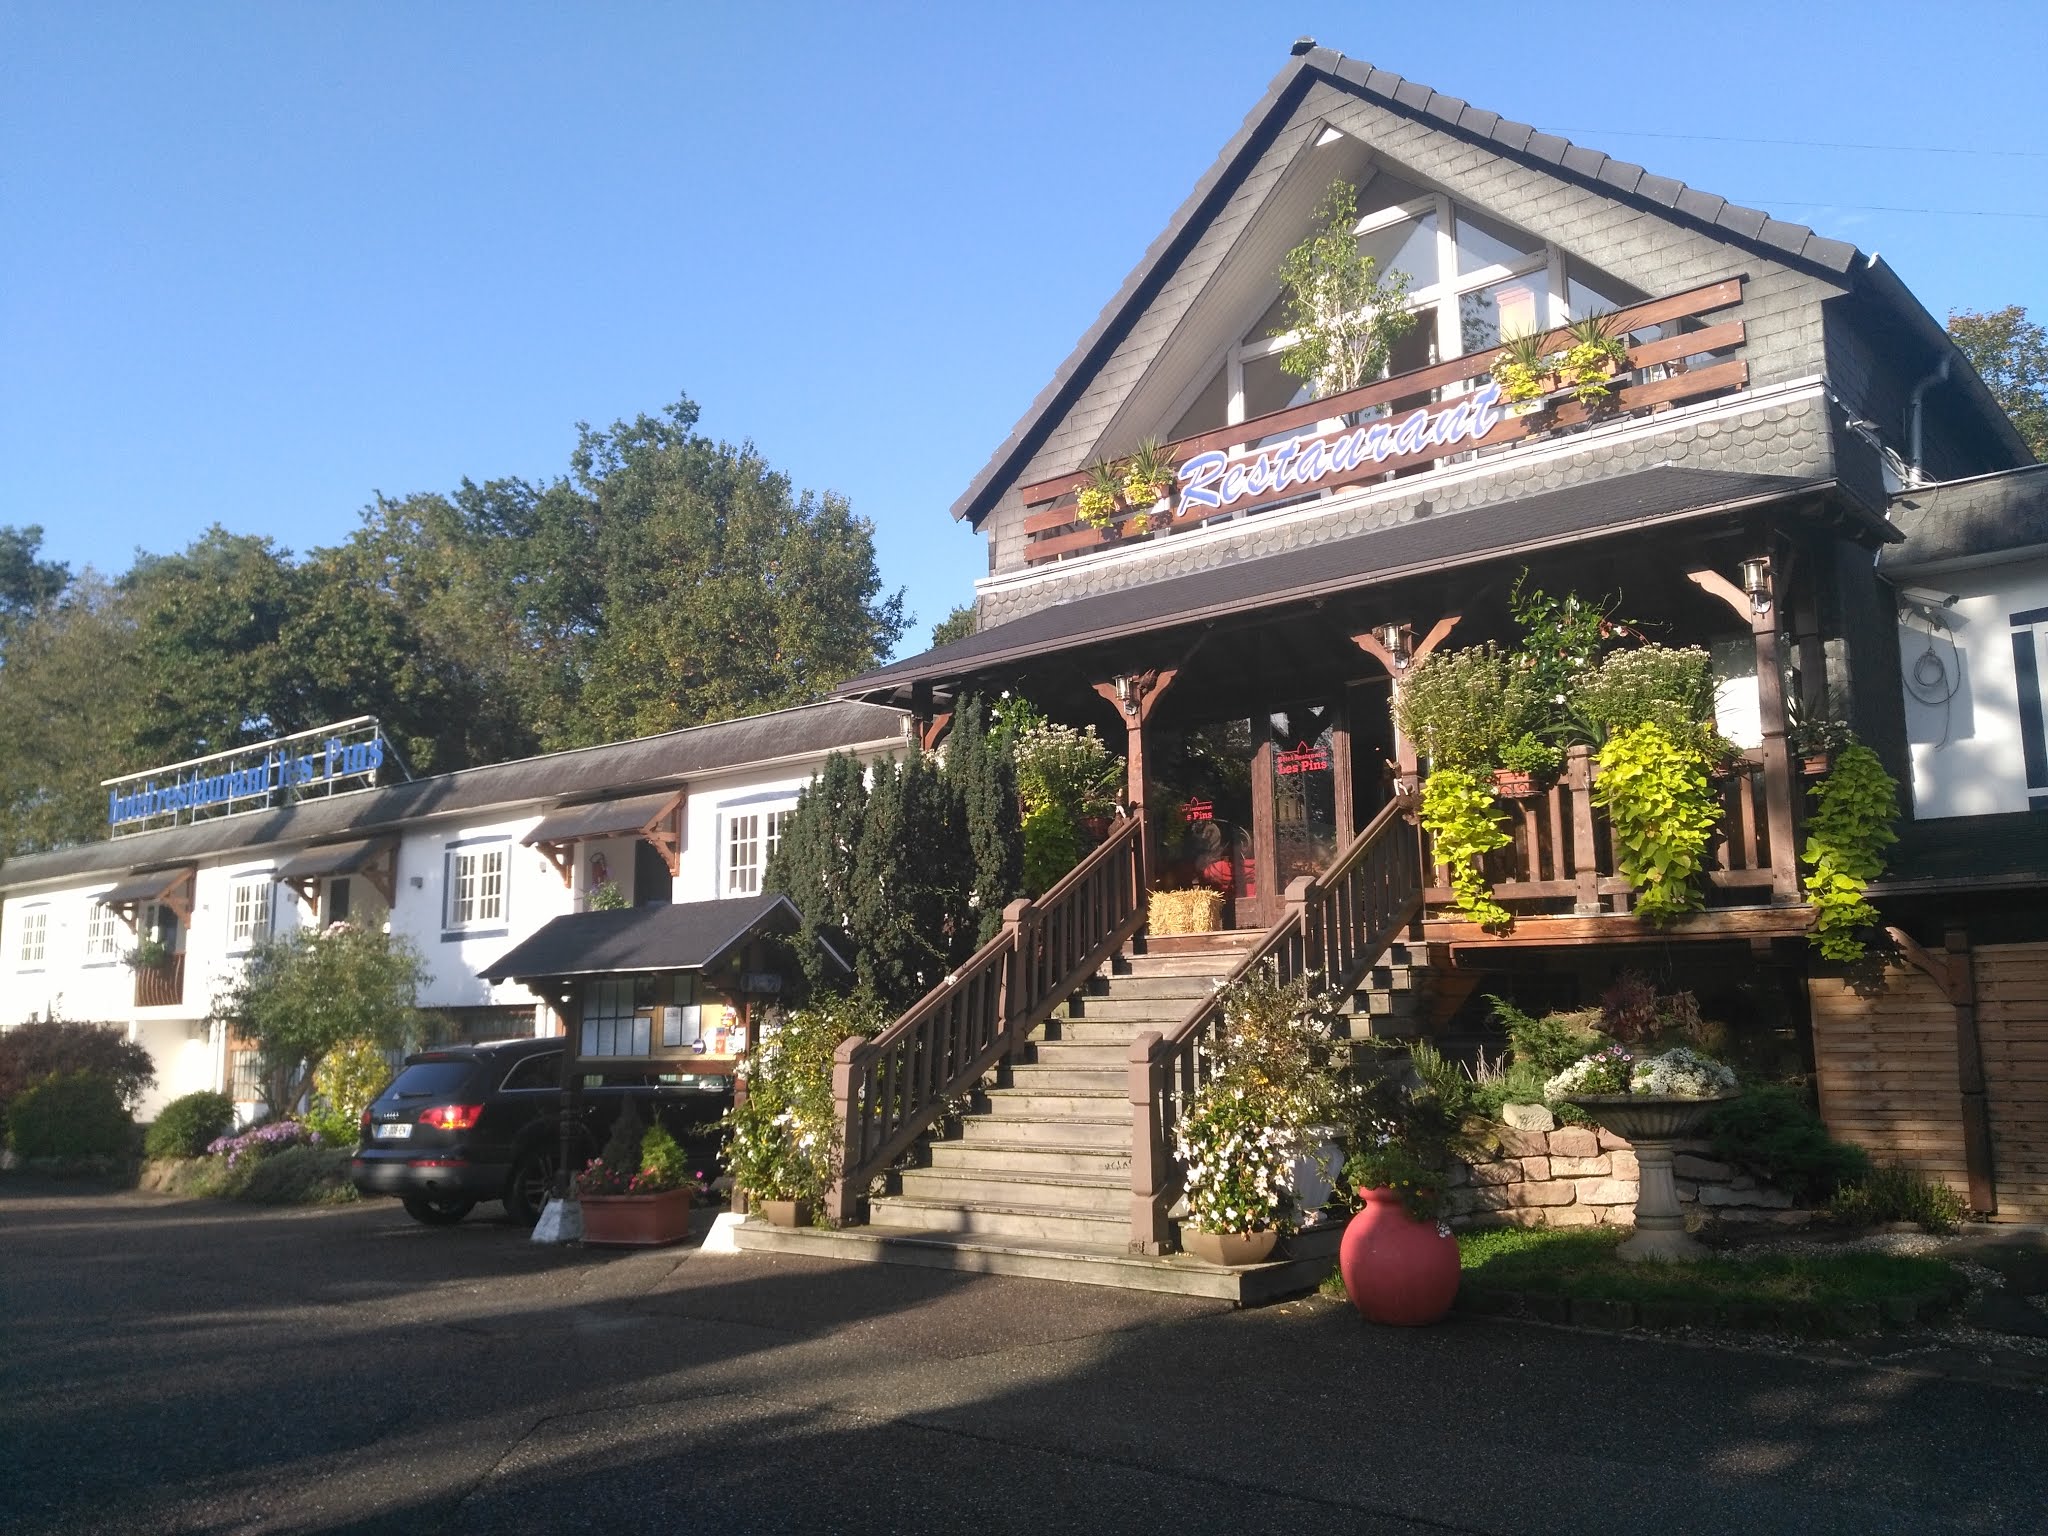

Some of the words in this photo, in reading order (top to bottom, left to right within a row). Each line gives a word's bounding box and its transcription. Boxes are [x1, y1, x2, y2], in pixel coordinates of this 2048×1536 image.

[1177, 383, 1501, 516] Restaurant
[156, 755, 269, 812] restaurant
[278, 751, 314, 788] les
[322, 738, 384, 779] Pins
[1278, 763, 1299, 775] Les
[1301, 760, 1328, 772] Pins
[1193, 811, 1213, 820] Pins
